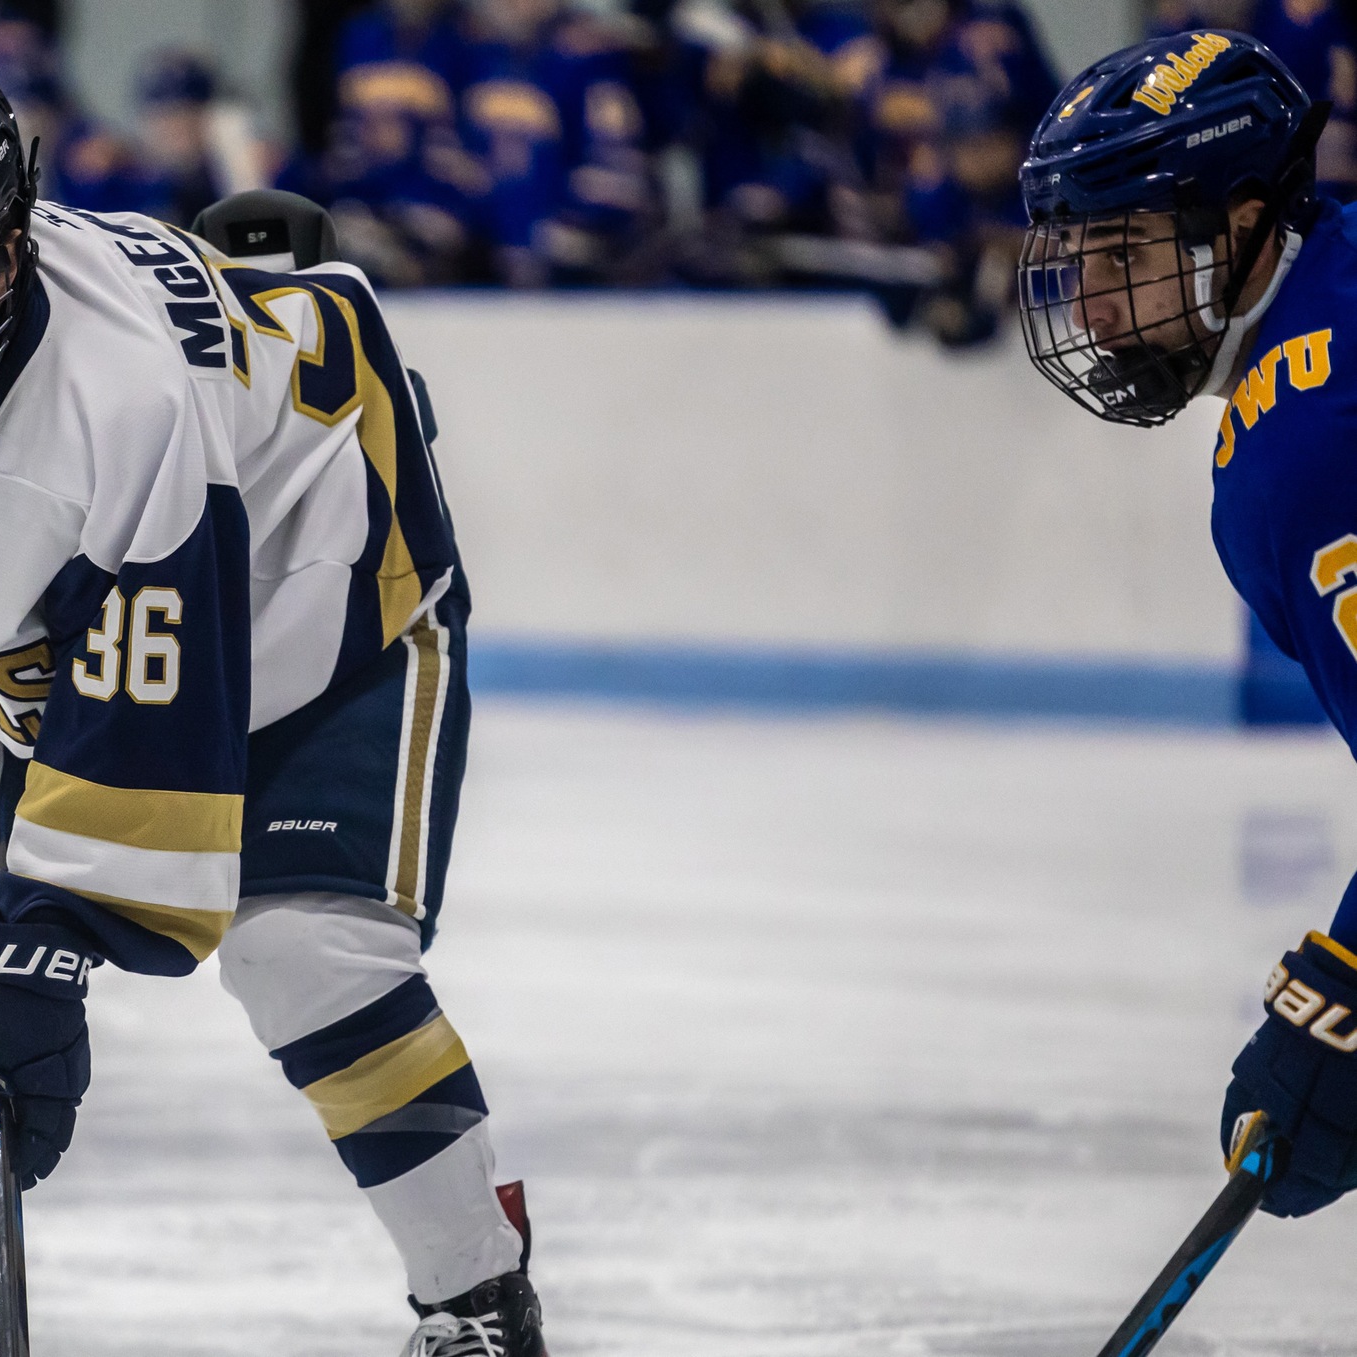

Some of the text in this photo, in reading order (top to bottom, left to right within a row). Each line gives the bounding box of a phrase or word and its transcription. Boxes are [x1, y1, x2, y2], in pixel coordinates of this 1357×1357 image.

[1133, 32, 1231, 116] Wildcats
[1186, 115, 1252, 149] BAUER
[1215, 329, 1332, 468] JWU
[71, 586, 183, 705] 36
[267, 819, 338, 833] BAUER
